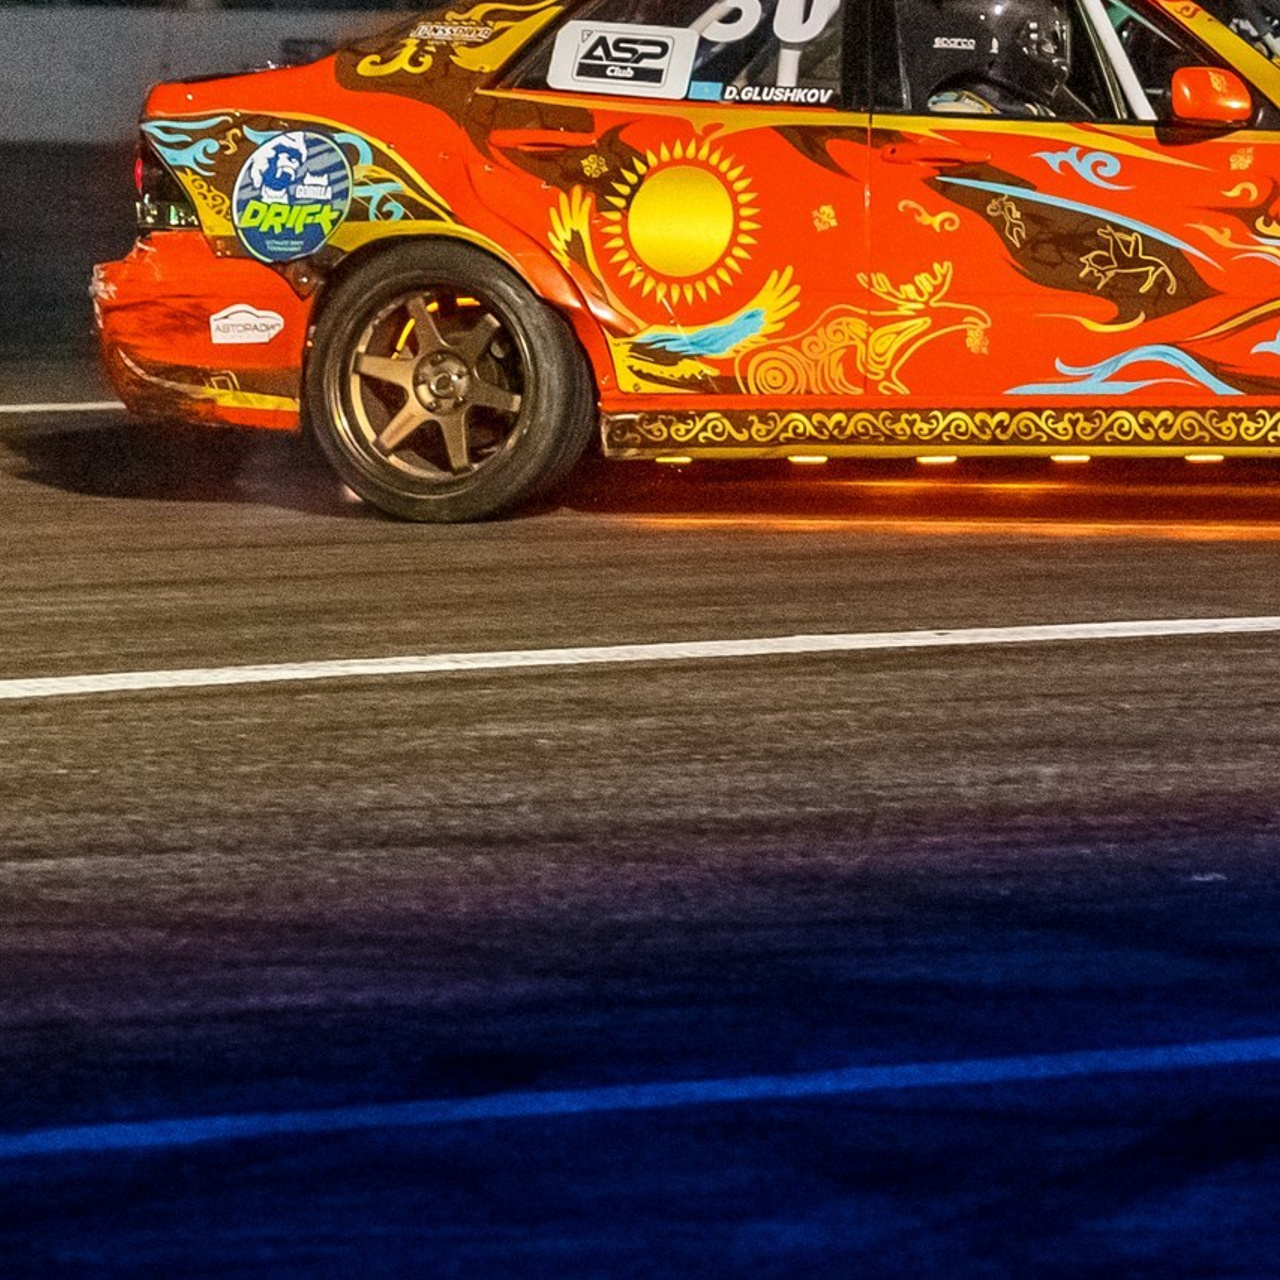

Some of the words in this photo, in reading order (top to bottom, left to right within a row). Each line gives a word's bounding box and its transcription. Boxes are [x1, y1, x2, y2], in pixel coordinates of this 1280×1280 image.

[579, 35, 669, 64] ASP
[605, 66, 634, 78] Club
[723, 86, 833, 103] D.GLUSHKOV
[295, 185, 332, 200] GORILLA
[241, 200, 340, 236] DRIFT
